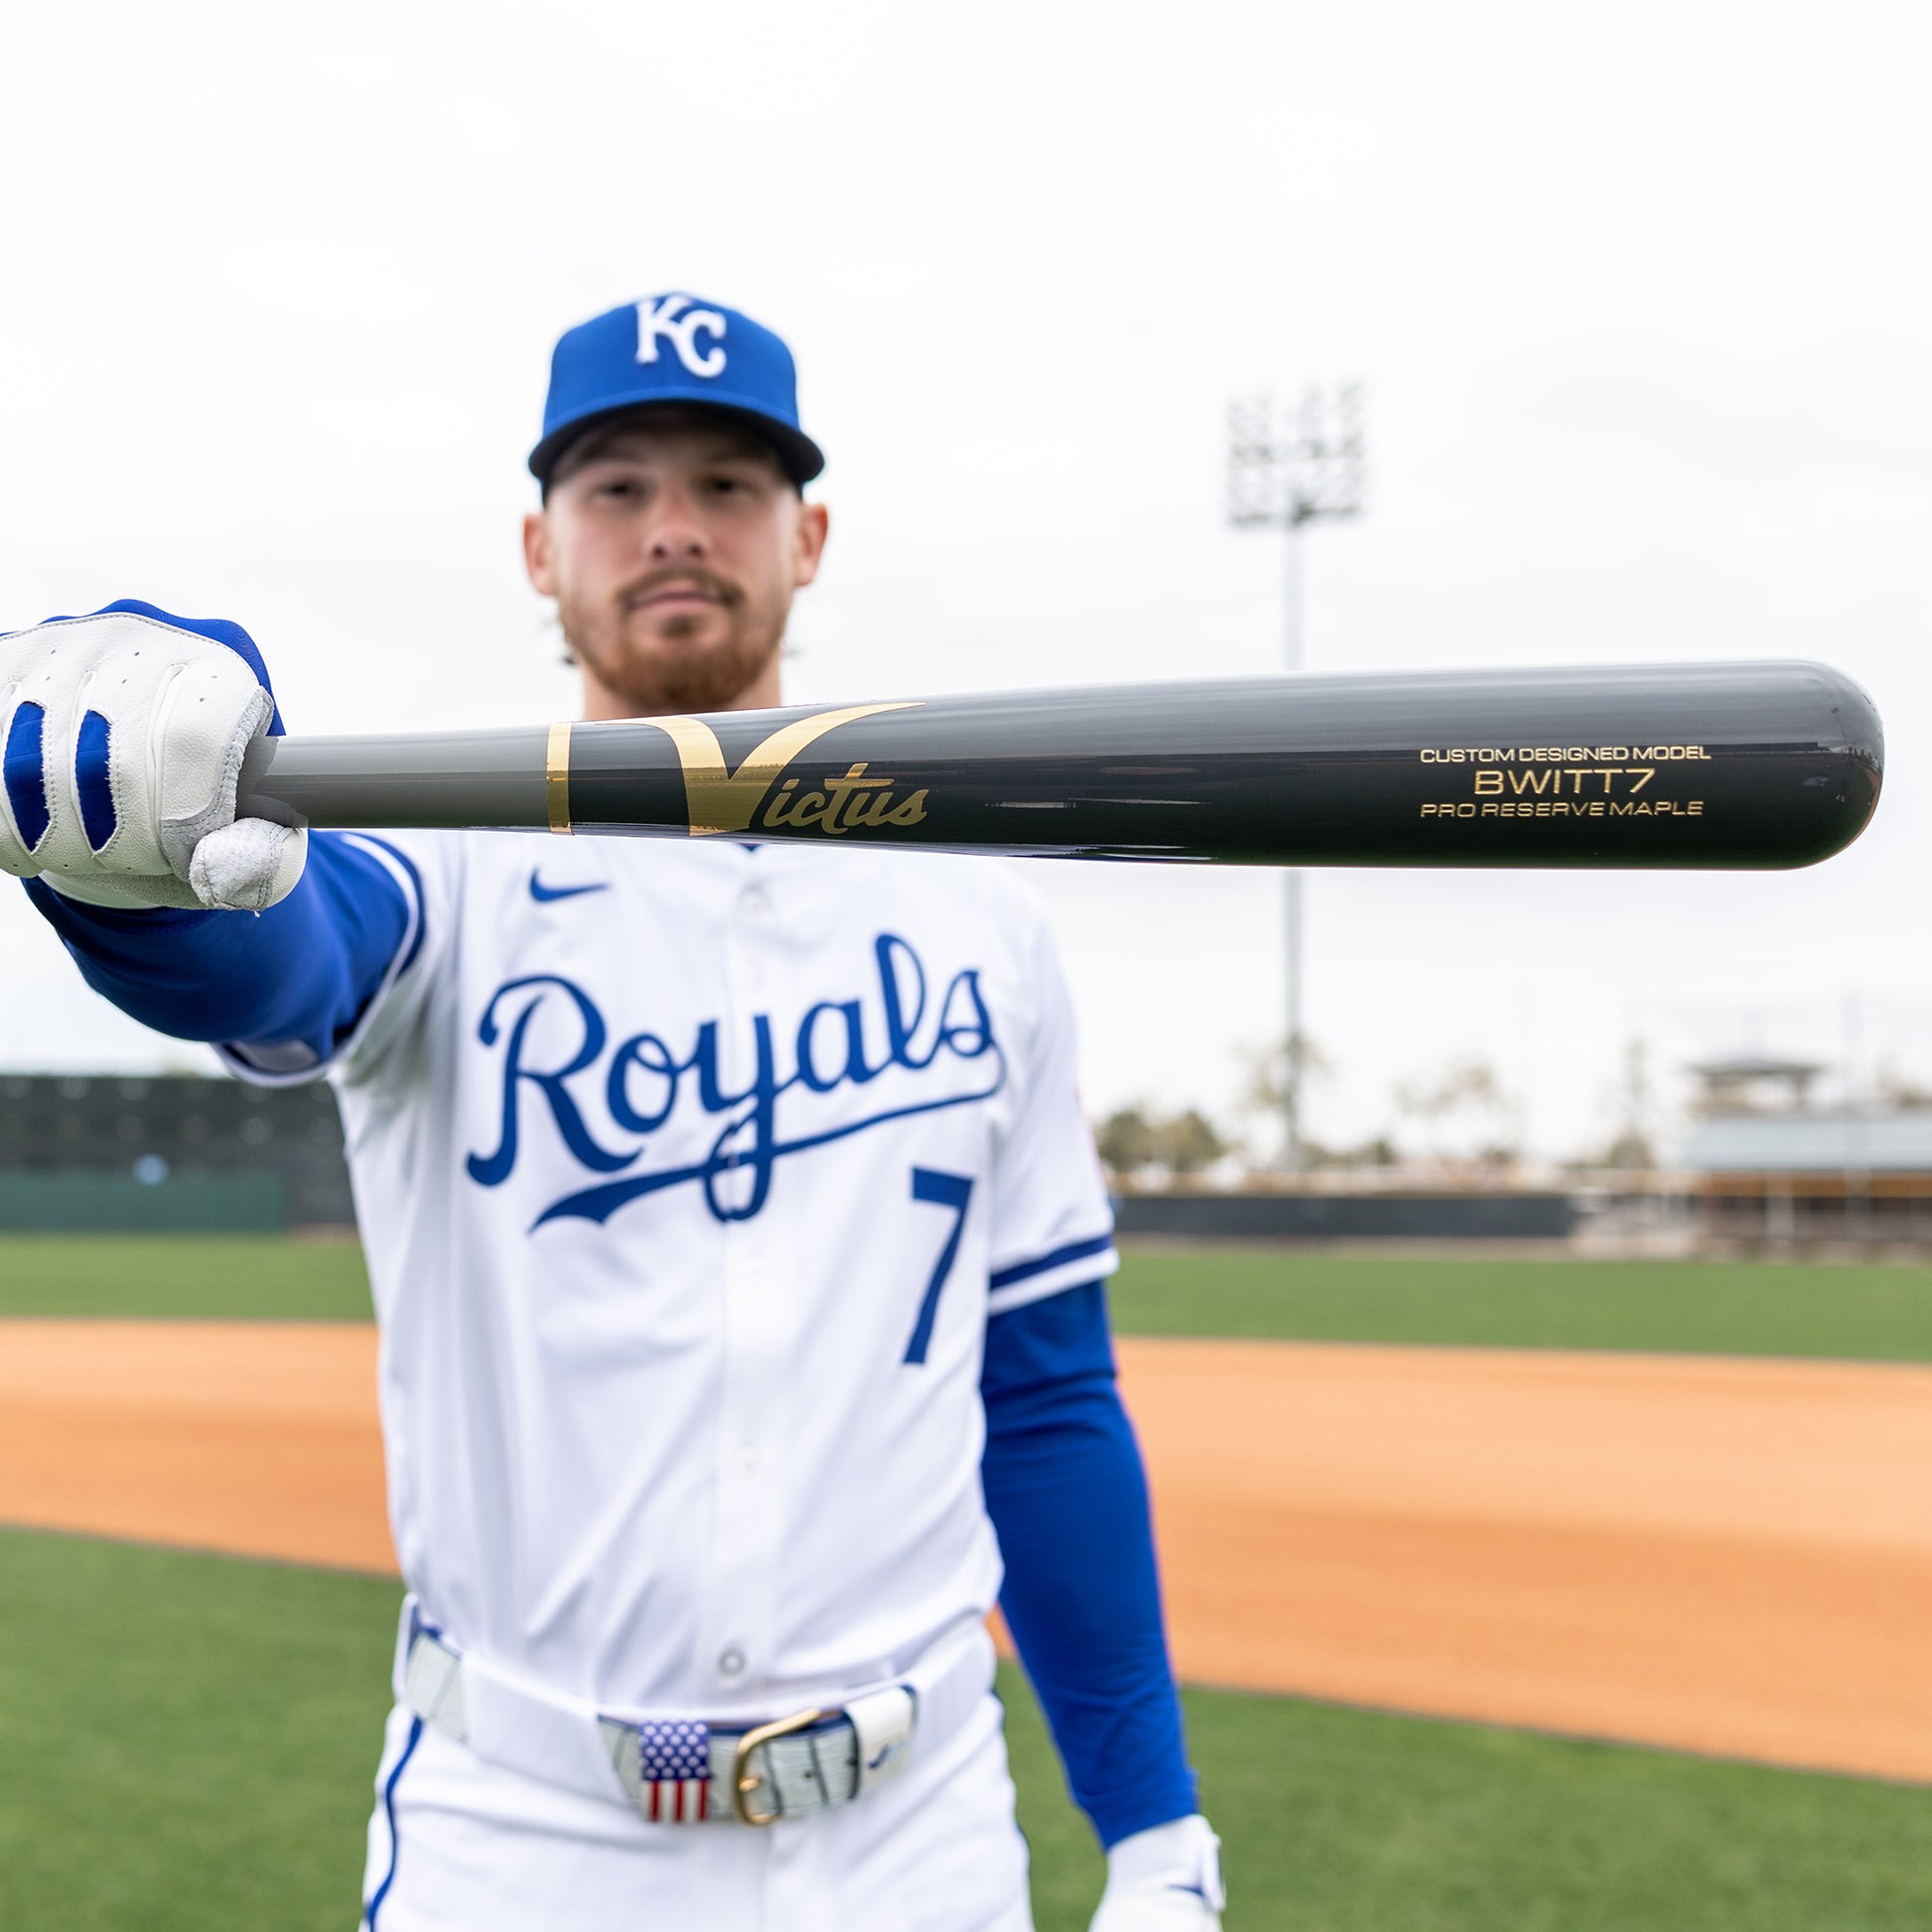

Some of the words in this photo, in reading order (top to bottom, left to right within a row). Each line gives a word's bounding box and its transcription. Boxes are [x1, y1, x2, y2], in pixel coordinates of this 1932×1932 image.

[634, 295, 727, 378] KC
[596, 702, 929, 837] Victus
[1420, 748, 1514, 763] CUSTOM
[1518, 747, 1629, 761] DESIGNED
[1632, 746, 1713, 760] MODEL
[1474, 768, 1656, 795] BWITT7
[1420, 802, 1476, 818] PRO
[1480, 802, 1605, 817] RESERVE
[1608, 800, 1705, 816] MAPLE
[465, 932, 1006, 1225] Royals
[902, 1165, 976, 1366] 7
